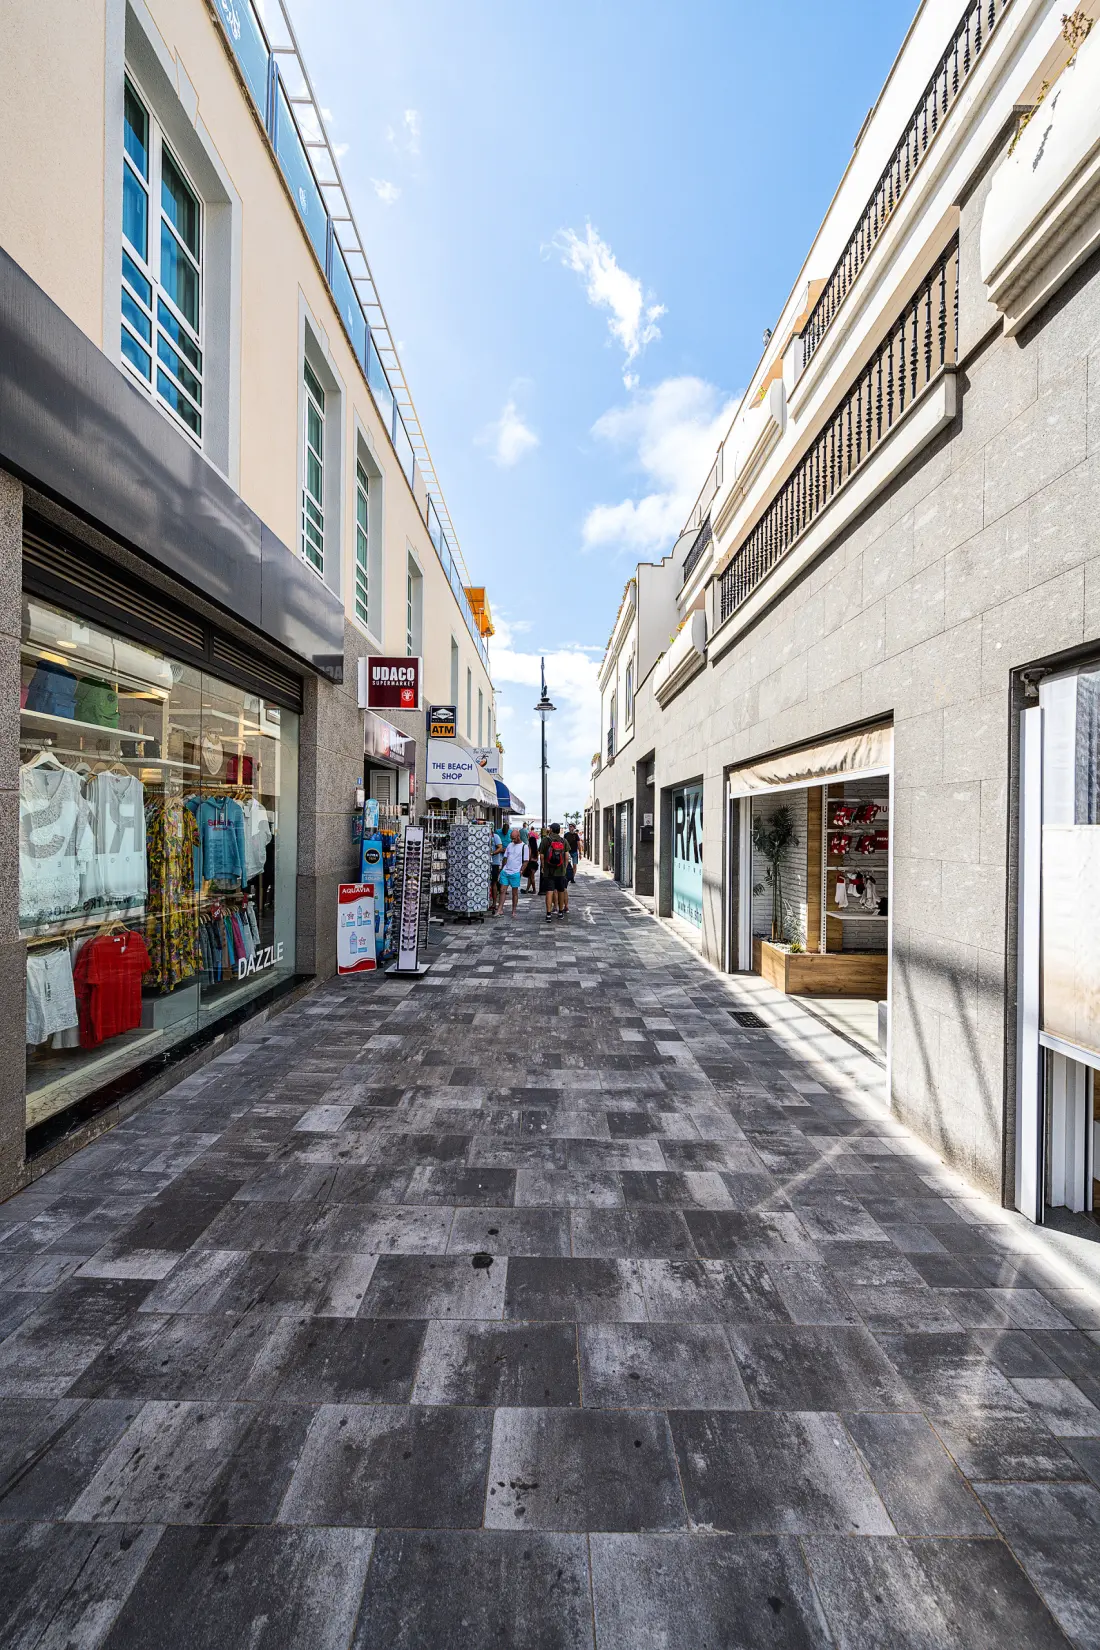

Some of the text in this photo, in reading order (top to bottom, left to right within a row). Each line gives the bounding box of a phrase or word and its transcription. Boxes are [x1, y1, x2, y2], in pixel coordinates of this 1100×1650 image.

[372, 666, 415, 681] UDACO
[431, 725, 454, 734] ATM
[432, 762, 473, 771] THE BEACH
[441, 772, 463, 780] SHOP
[238, 941, 284, 980] DAZZLE
